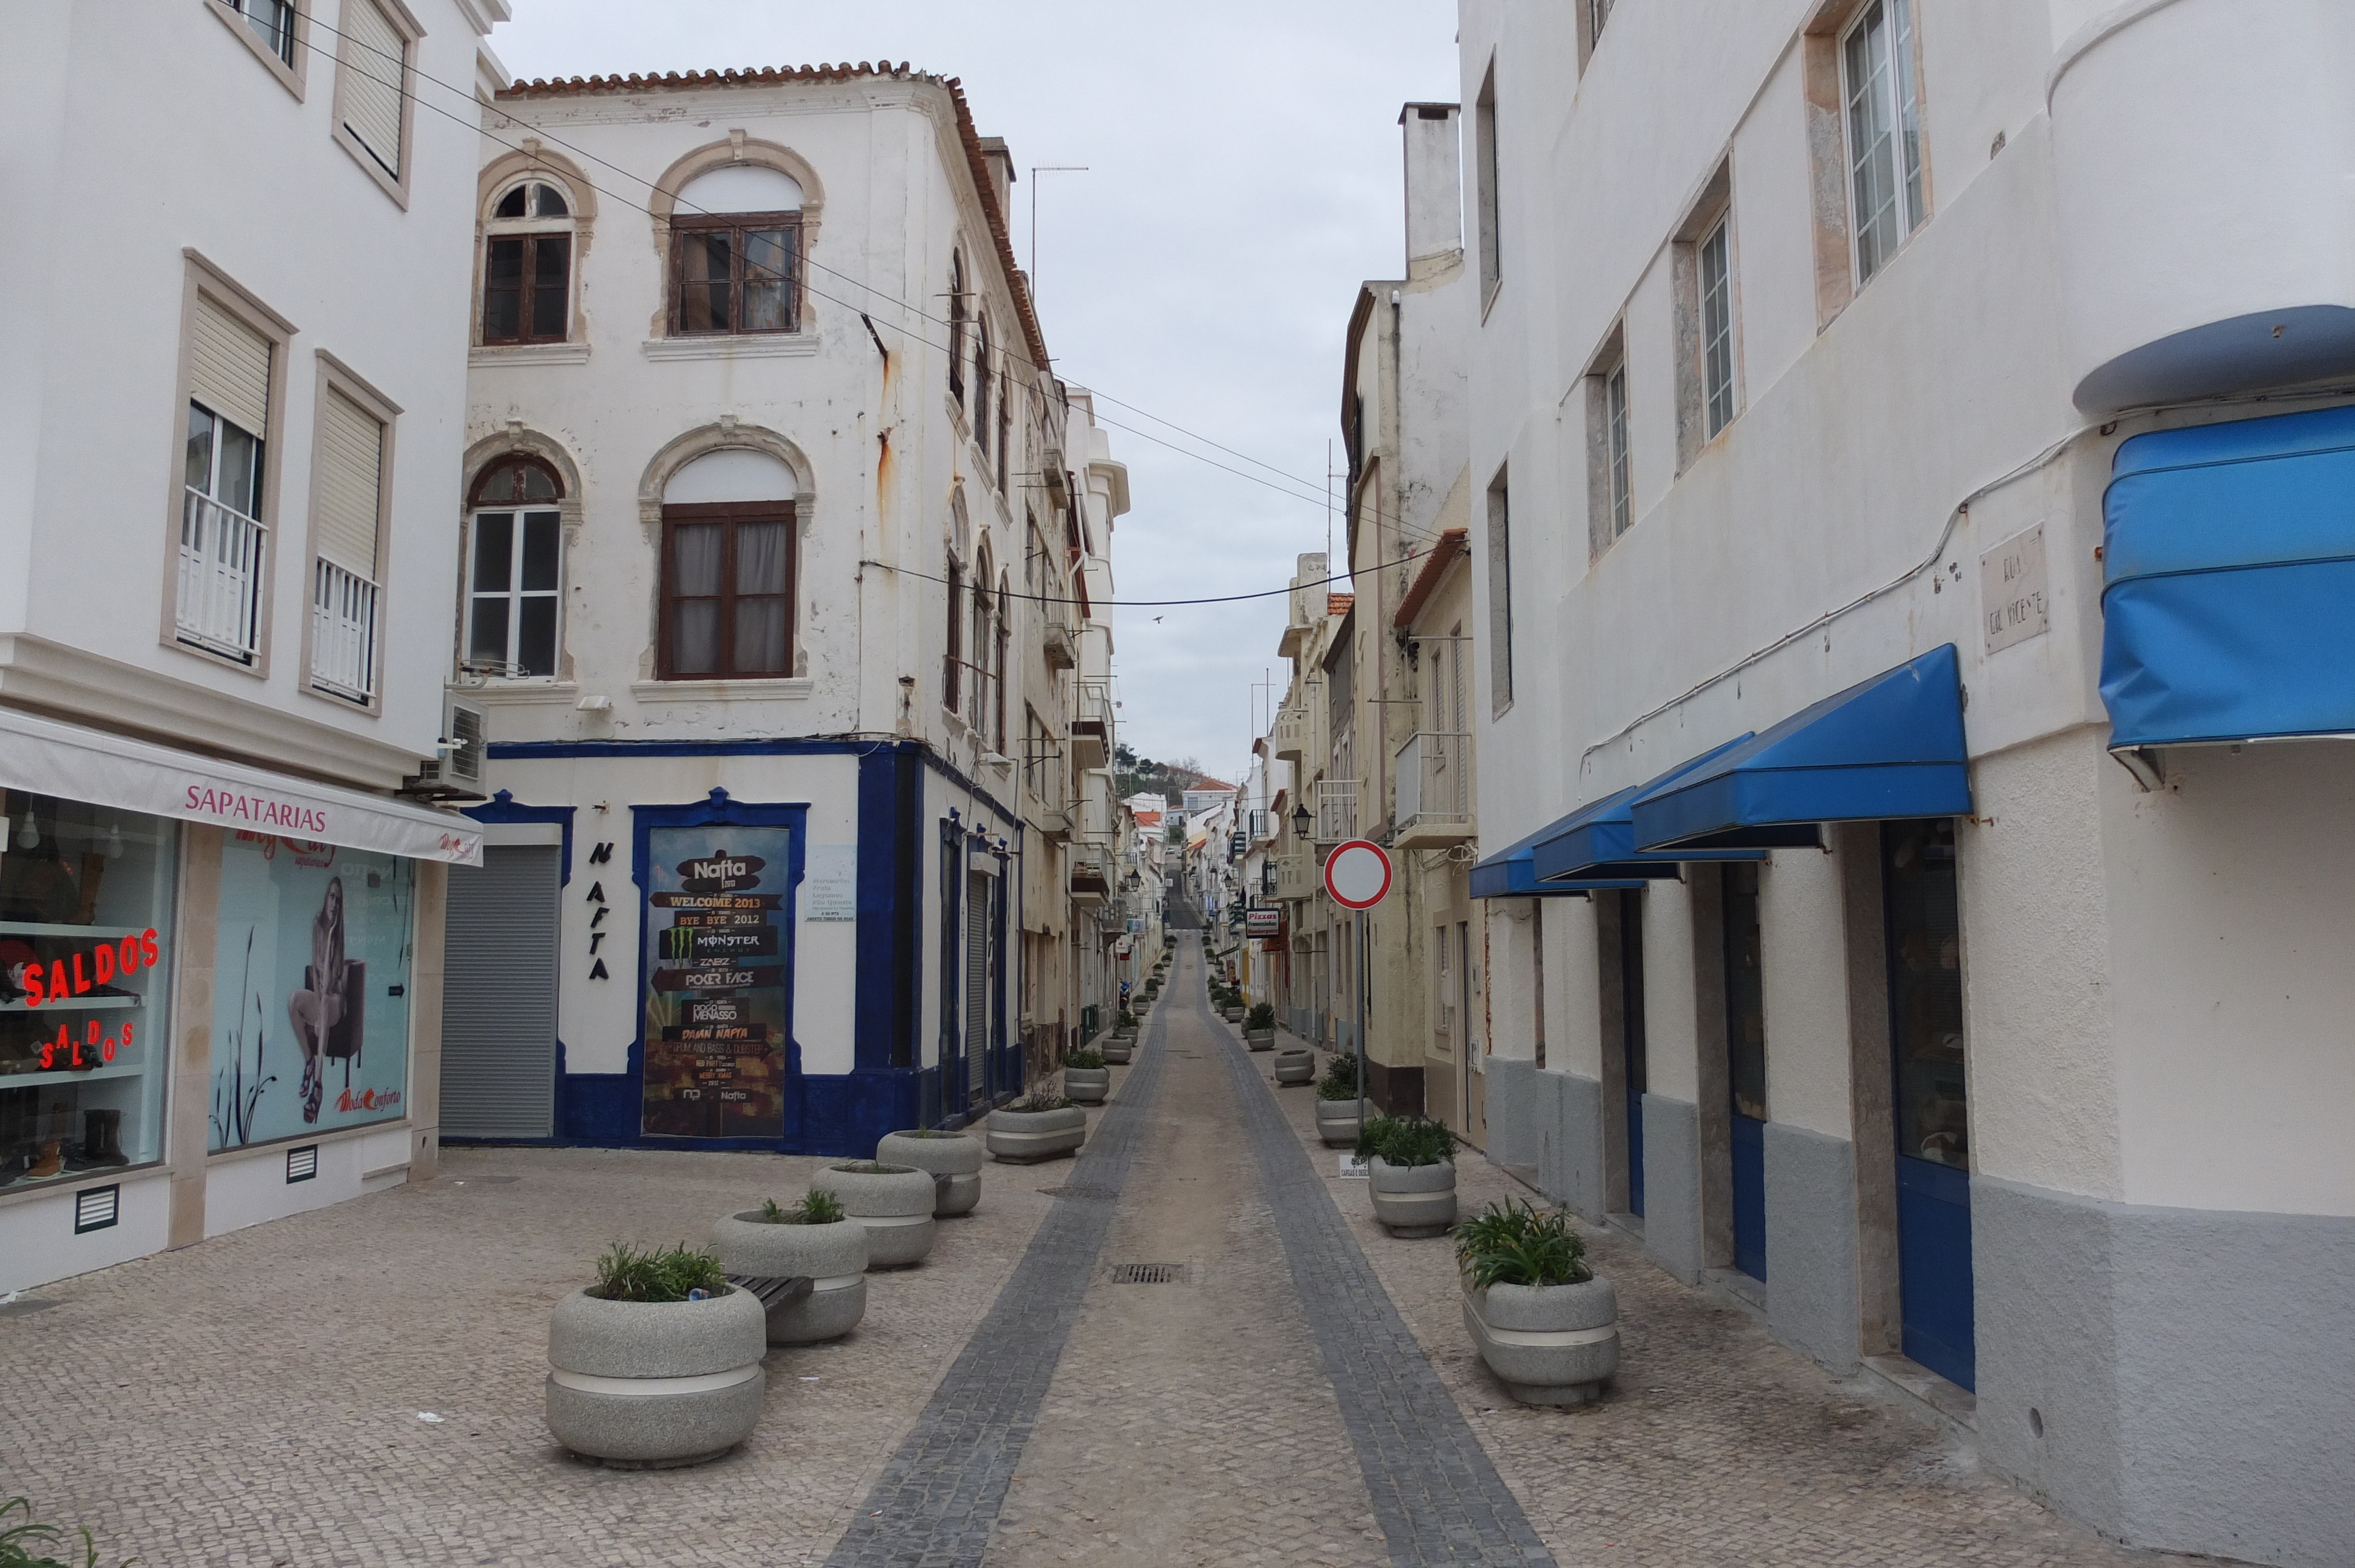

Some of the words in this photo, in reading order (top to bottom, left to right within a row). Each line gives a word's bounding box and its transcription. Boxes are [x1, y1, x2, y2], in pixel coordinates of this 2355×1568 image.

[2004, 555, 2021, 582] RUA
[1990, 610, 2002, 634] GIL
[2007, 591, 2042, 627] VICENTE
[185, 785, 326, 832] SAPATARIAS
[694, 860, 746, 889] Nafta
[586, 842, 615, 980] NAFTA
[671, 896, 732, 908] WELCOME
[735, 898, 761, 908] 2013
[680, 916, 700, 925] BYE
[706, 916, 727, 925] BYE
[735, 915, 759, 924] 2012
[698, 935, 760, 947] MONSTER
[22, 928, 158, 1007] SALDOS
[686, 974, 721, 986] POKER
[726, 971, 754, 984] FACE
[694, 1011, 737, 1022] MENASSO
[40, 1019, 134, 1068] SALDOS
[682, 1029, 711, 1040] DAMN
[717, 1028, 748, 1039] NAFTA
[673, 1042, 691, 1052] DRUM
[693, 1043, 706, 1052] AND
[708, 1044, 724, 1053] BASS
[726, 1044, 731, 1054] &
[734, 1044, 762, 1054] DUBSTEP
[334, 1088, 363, 1112] Moda
[363, 1087, 401, 1111] Conforto
[721, 1091, 747, 1102] Nafta
